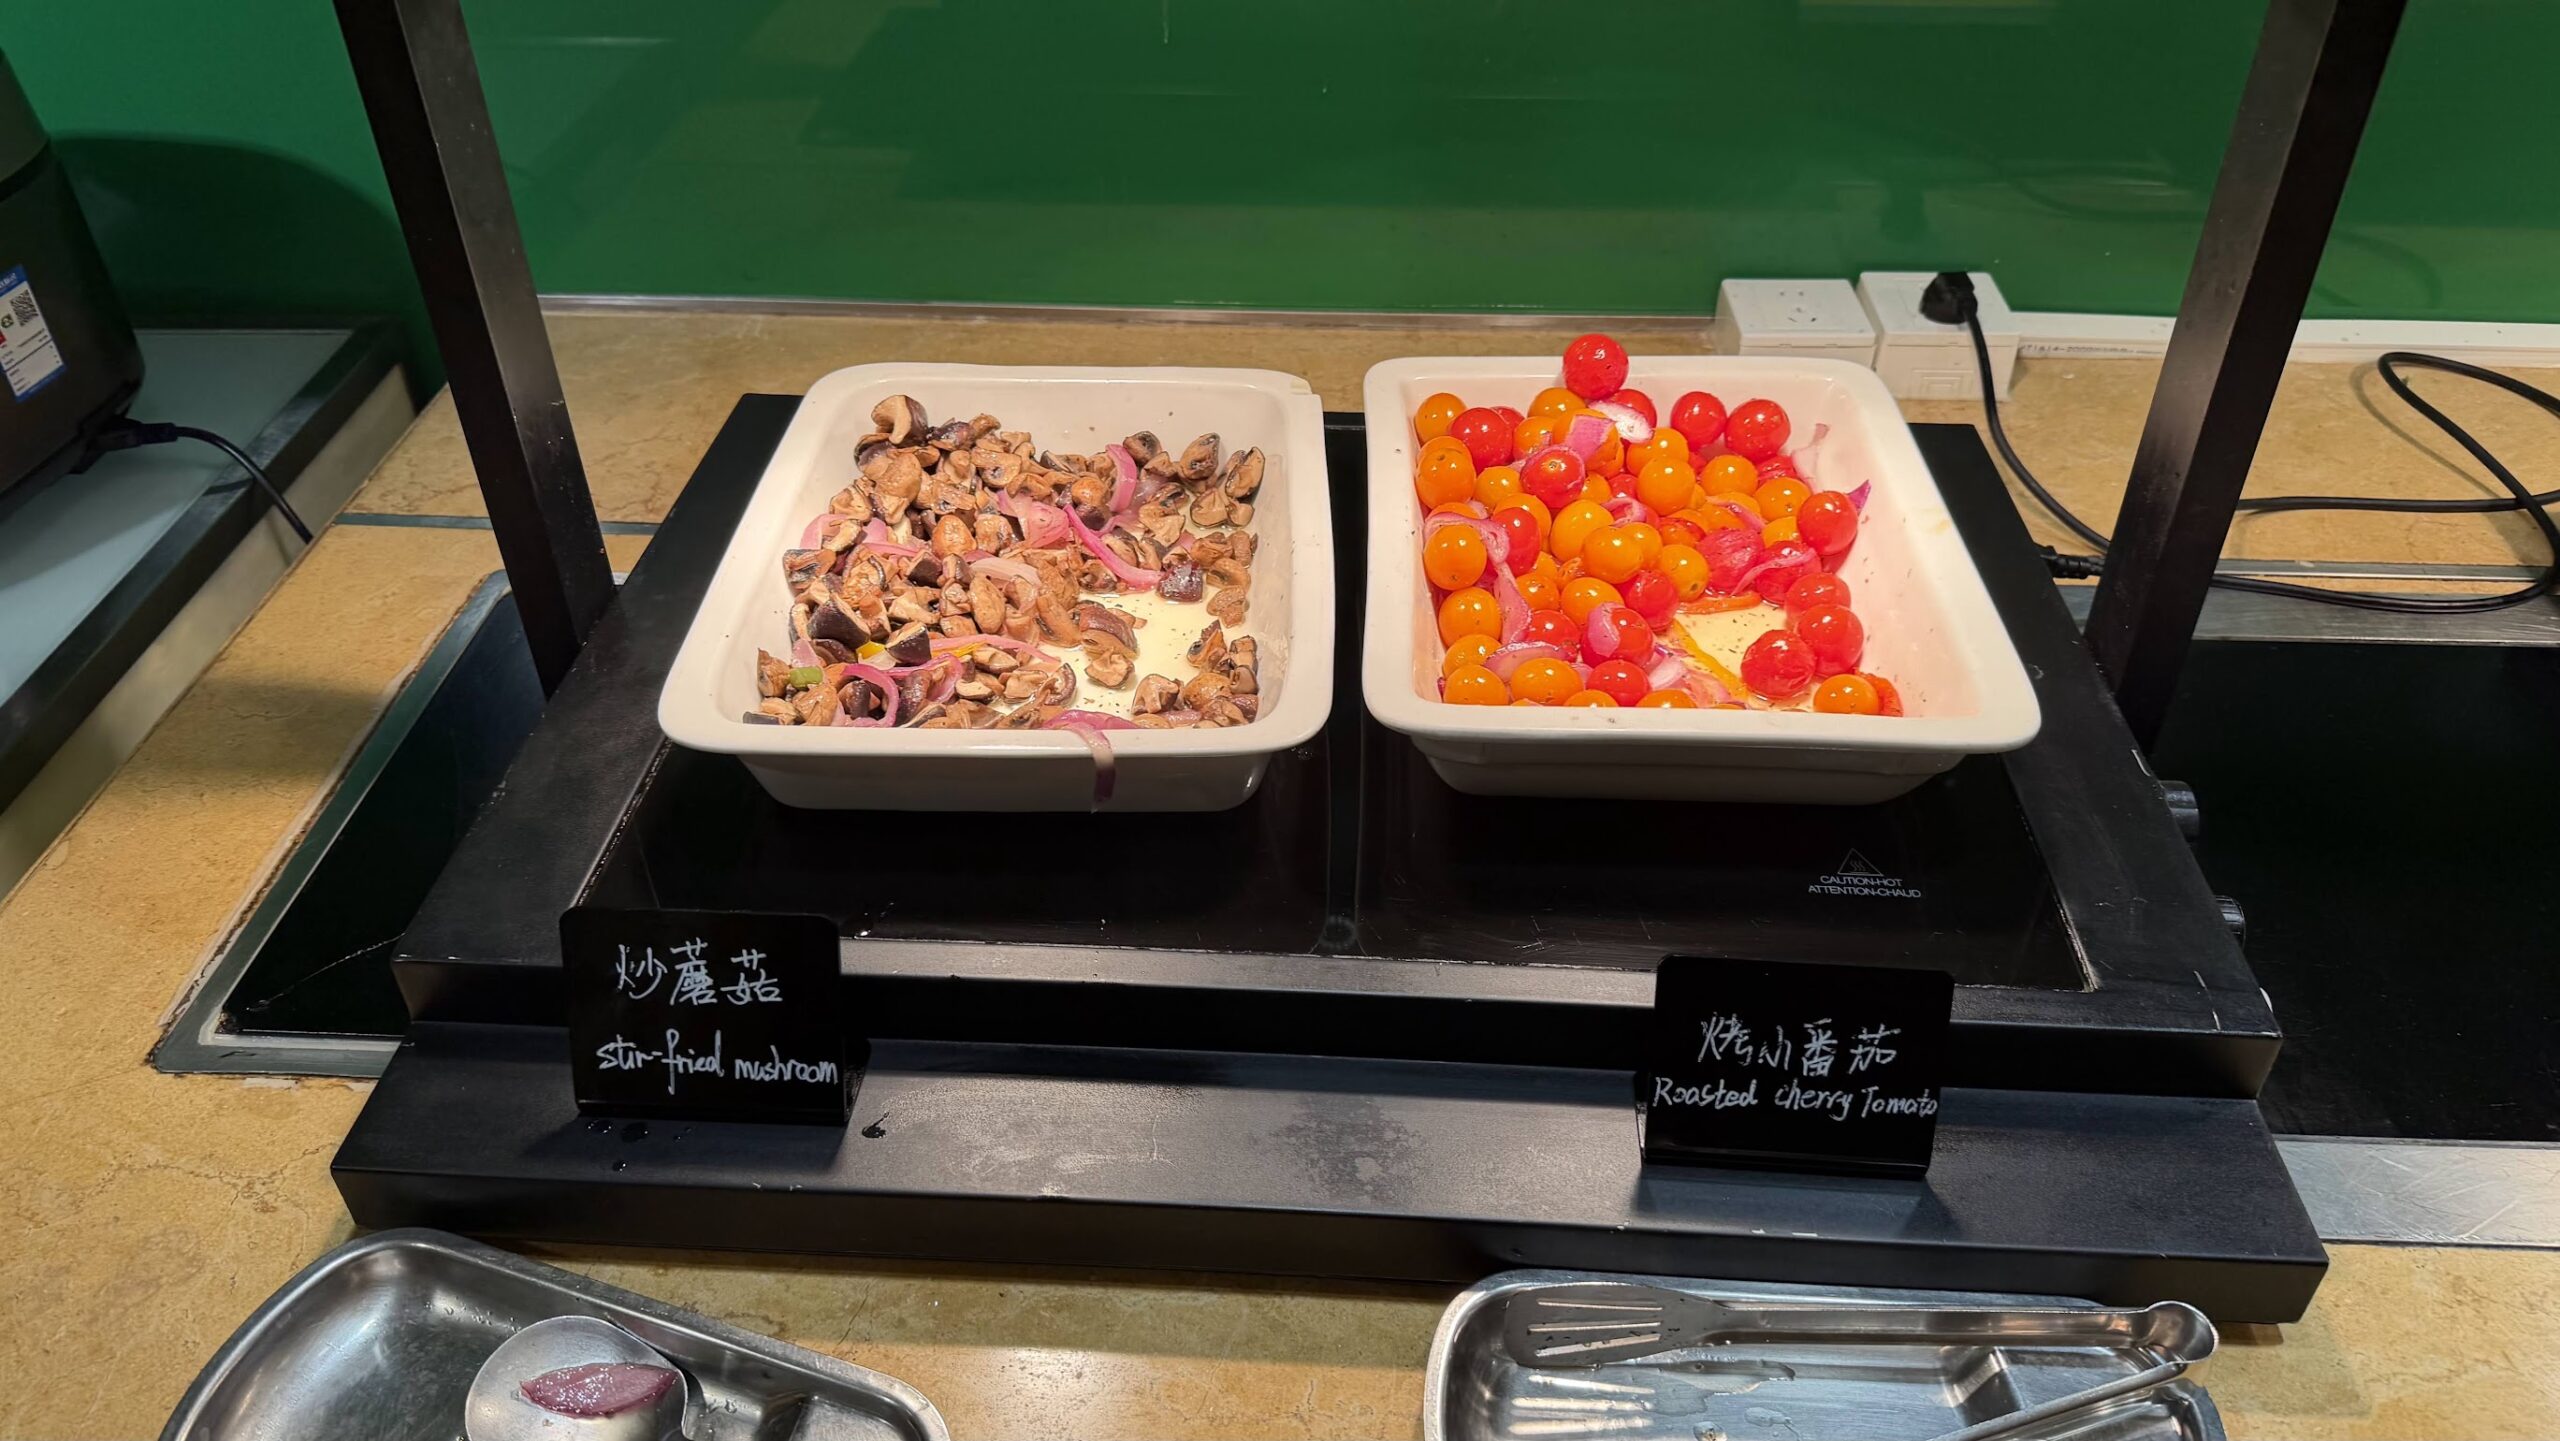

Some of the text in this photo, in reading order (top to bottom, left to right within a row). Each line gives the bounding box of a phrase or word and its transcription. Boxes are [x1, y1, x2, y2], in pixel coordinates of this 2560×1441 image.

[1808, 884, 1922, 898] ATTENTION-CHAUD
[1819, 875, 1903, 887] CAUTION-HOT
[615, 936, 783, 1006] 炒蘑菇
[1697, 1011, 1902, 1077] 烤小番茄
[734, 1045, 839, 1085] mushroom
[1652, 1076, 1759, 1110] Roasted
[1860, 1085, 1939, 1118] Tomato
